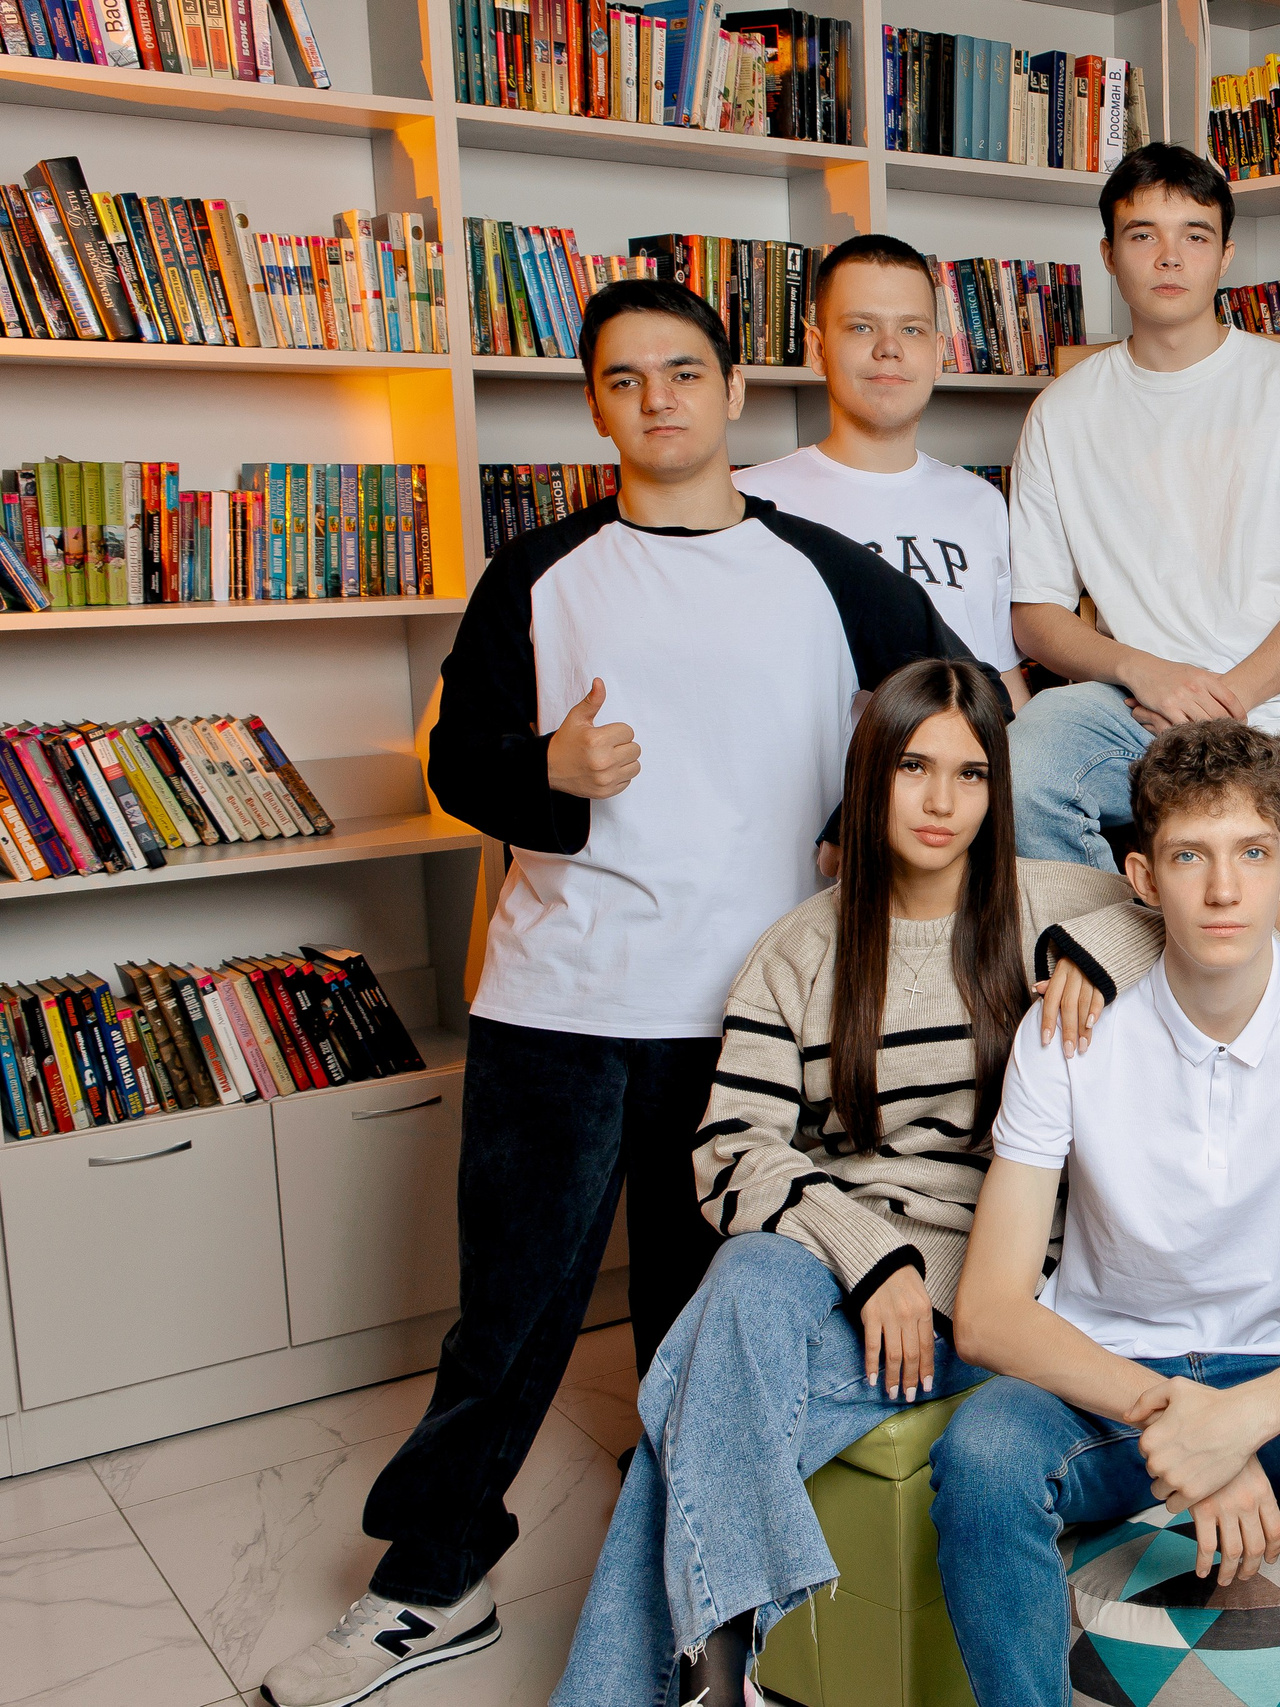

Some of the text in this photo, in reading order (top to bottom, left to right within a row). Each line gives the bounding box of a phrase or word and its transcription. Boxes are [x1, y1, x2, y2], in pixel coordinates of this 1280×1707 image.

[30, 13, 46, 46] КОГОРТА
[239, 20, 250, 56] БОРИС
[1107, 68, 1121, 147] Гроссман В.
[964, 137, 968, 147] 1
[978, 140, 984, 149] 2
[996, 141, 1002, 151] 3
[149, 202, 174, 262] Н. ВАСИНА
[173, 204, 191, 252] ВАСИНА
[84, 241, 114, 309] КРЕМЛЕВСКИЕ
[188, 253, 198, 265] Н.
[1, 286, 16, 317] ВАСИЛЬЕВ
[154, 283, 175, 336] НИНА ВАСИНА
[321, 291, 338, 340] Веденская
[967, 284, 987, 350] ЦИКЛОГЕКСАН
[787, 338, 795, 353] Судья
[276, 479, 284, 516] ВЕРЕСОВ
[129, 534, 138, 595] ВЕРБИНИНА
[420, 527, 431, 573] ВЕРЕСОВ
[861, 536, 968, 589] AP
[2, 804, 46, 871] ВЕРНЫЙ
[180, 984, 204, 1021] МЕДВЕДЬ
[209, 997, 226, 1025] Авиатор
[277, 984, 319, 1070] ВОИНЫ КРЕАТИВА
[111, 1029, 136, 1089] ТРЕТИЙ УДАР
[201, 1035, 232, 1093] ВЛАДИМИР ВЛАСОВ
[372, 1608, 439, 1661] N
